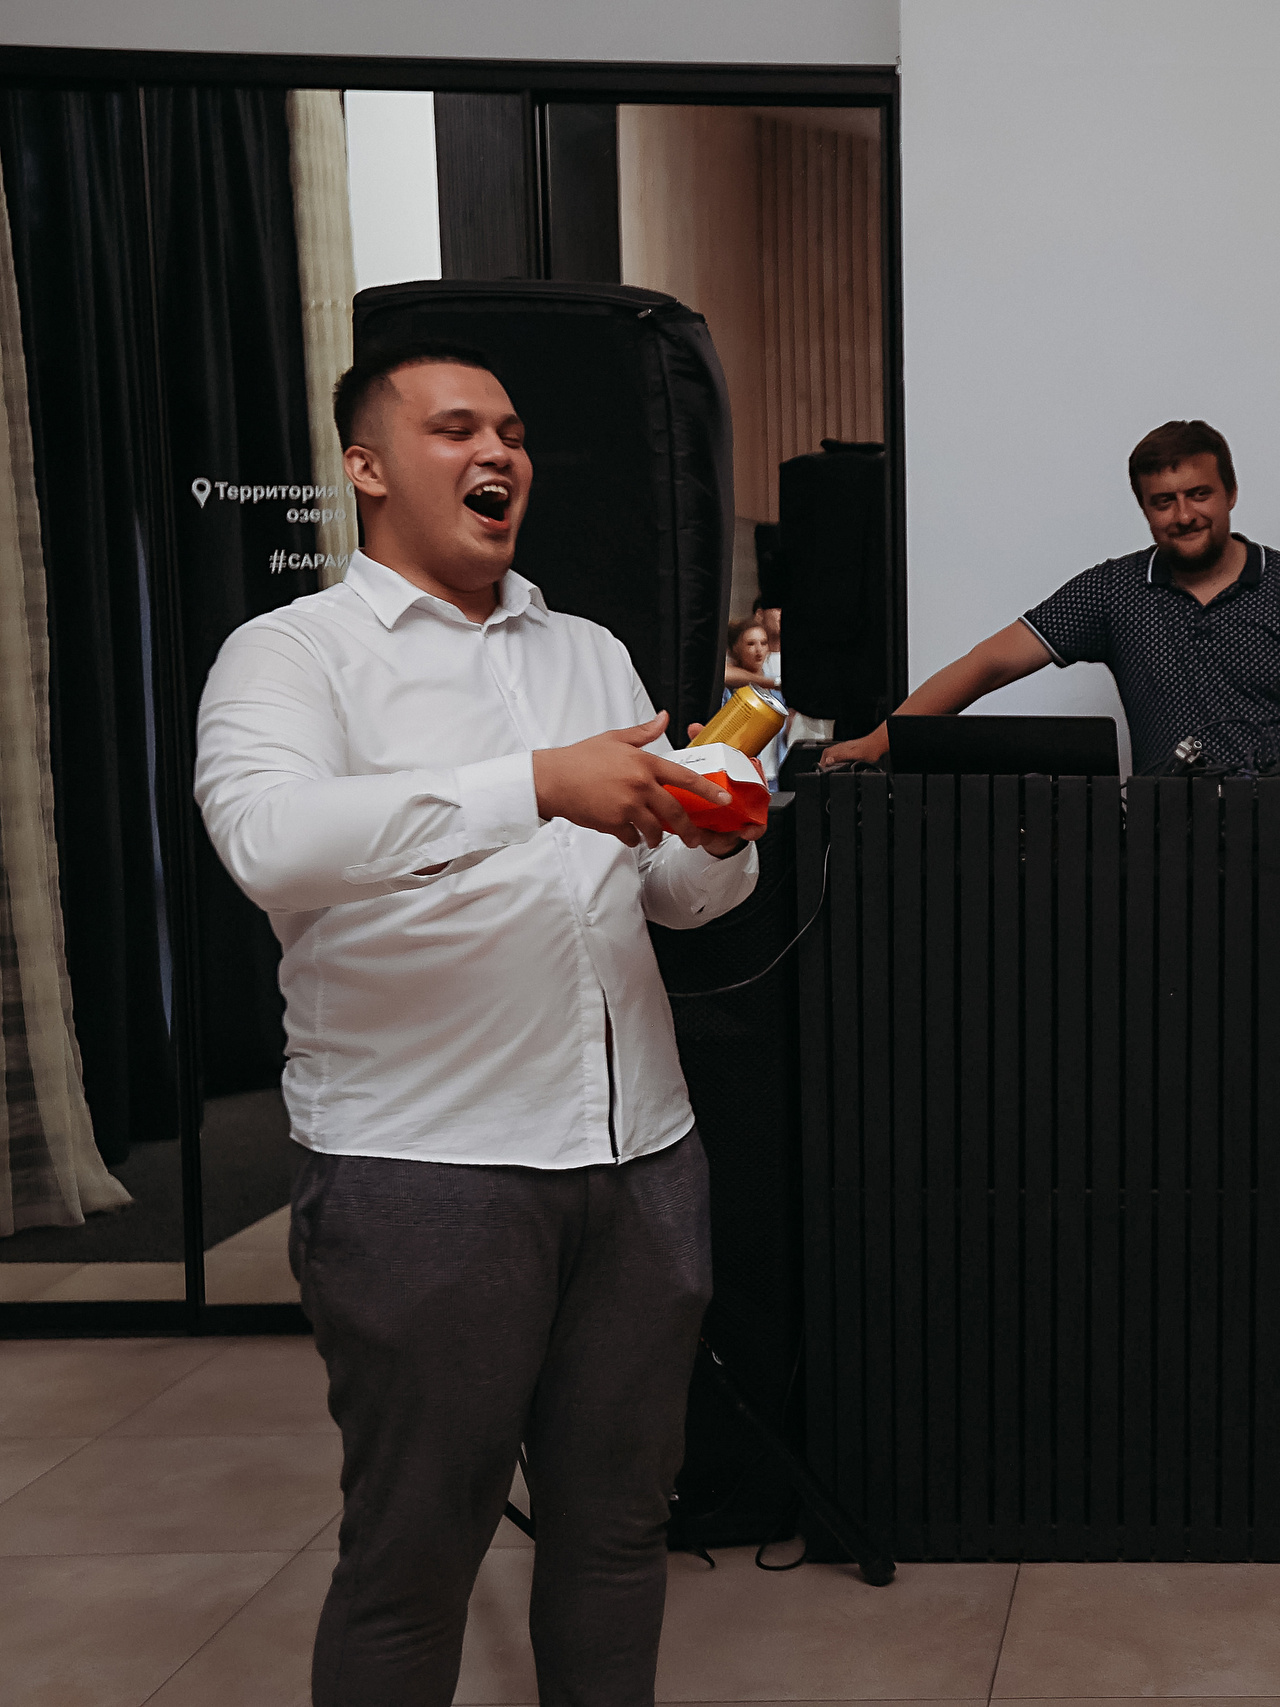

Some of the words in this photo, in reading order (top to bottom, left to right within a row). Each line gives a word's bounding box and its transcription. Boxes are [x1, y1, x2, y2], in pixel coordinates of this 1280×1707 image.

[214, 481, 338, 504] Территория
[286, 508, 347, 525] озеро
[269, 549, 353, 575] #САРАИ
